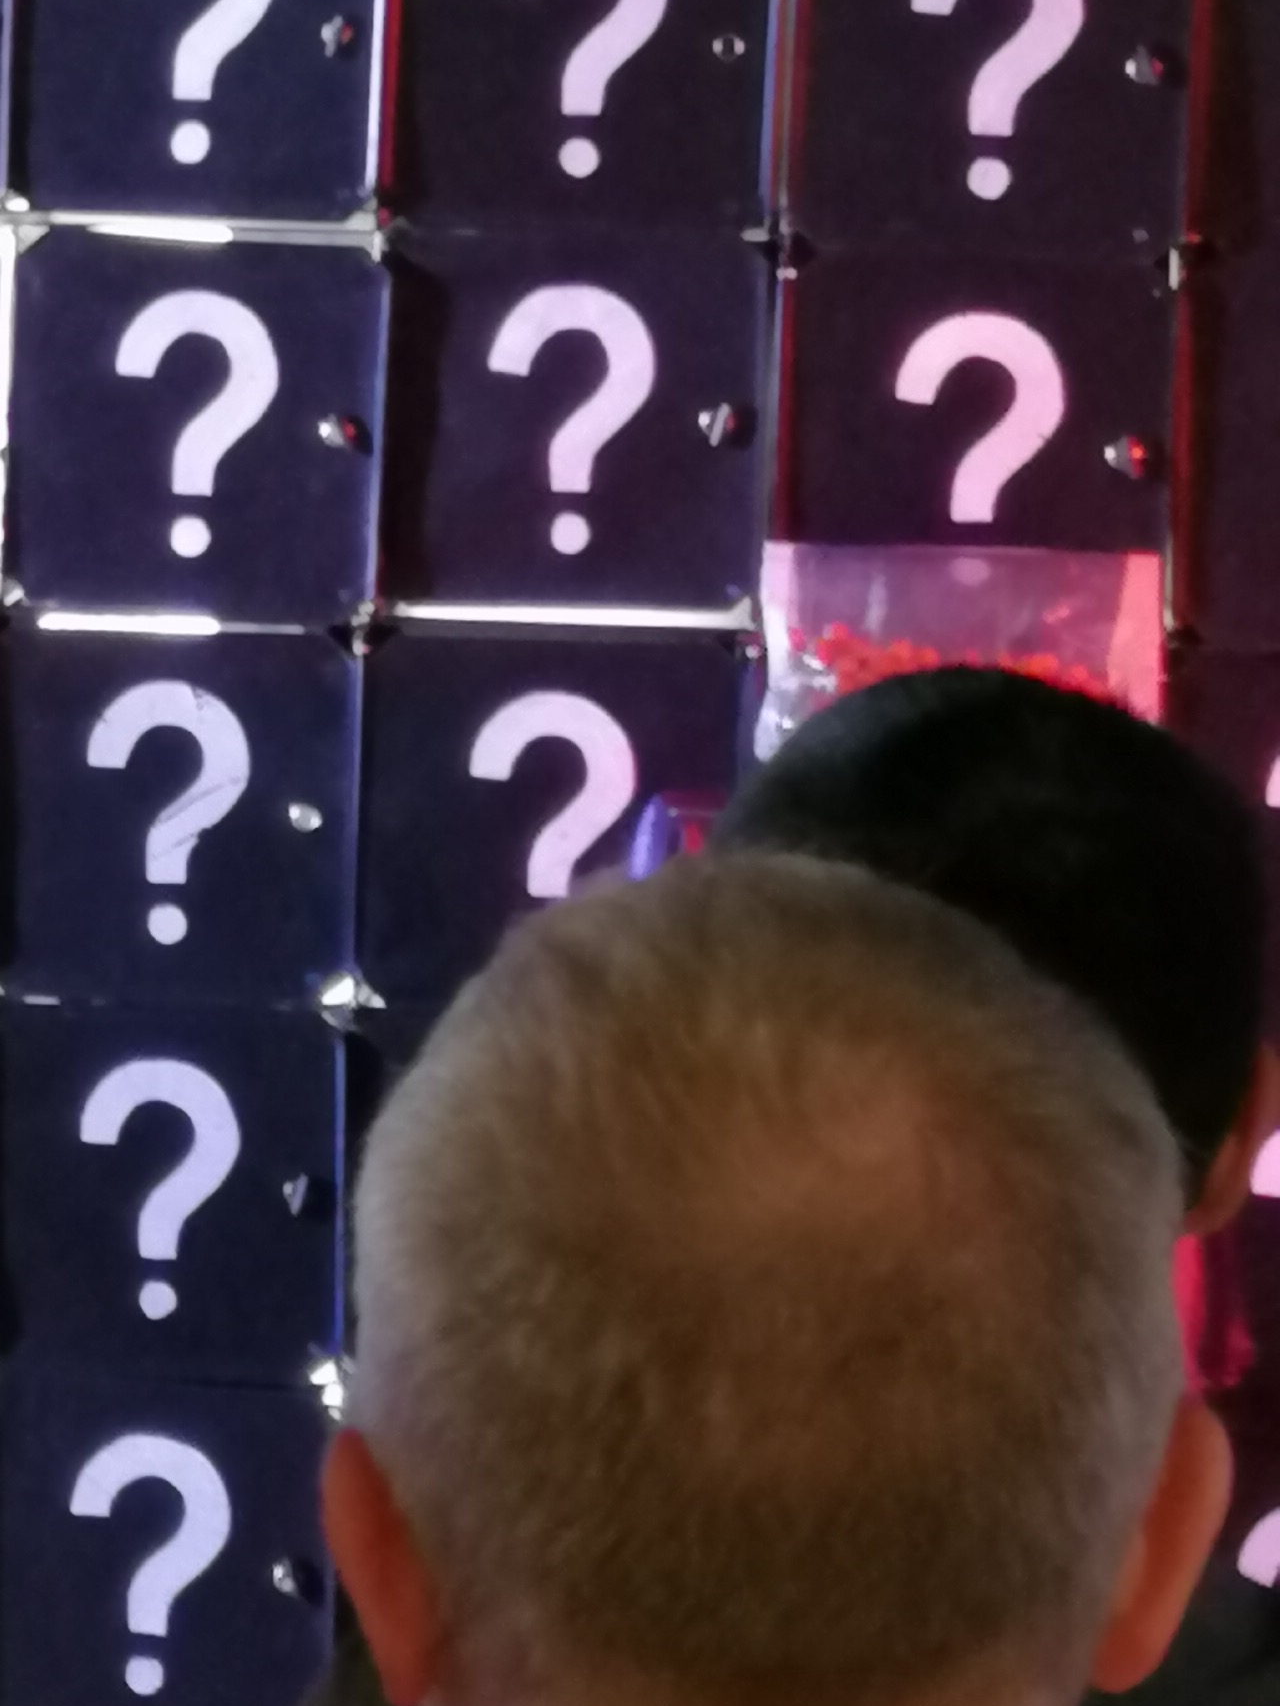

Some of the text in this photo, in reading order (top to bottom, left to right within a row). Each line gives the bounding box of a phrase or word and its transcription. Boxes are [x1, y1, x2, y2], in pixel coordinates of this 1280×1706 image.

[115, 290, 279, 558] ?
[487, 285, 655, 554] ?
[87, 680, 250, 945] ?
[80, 1057, 240, 1320] ?
[70, 1432, 231, 1695] ?
